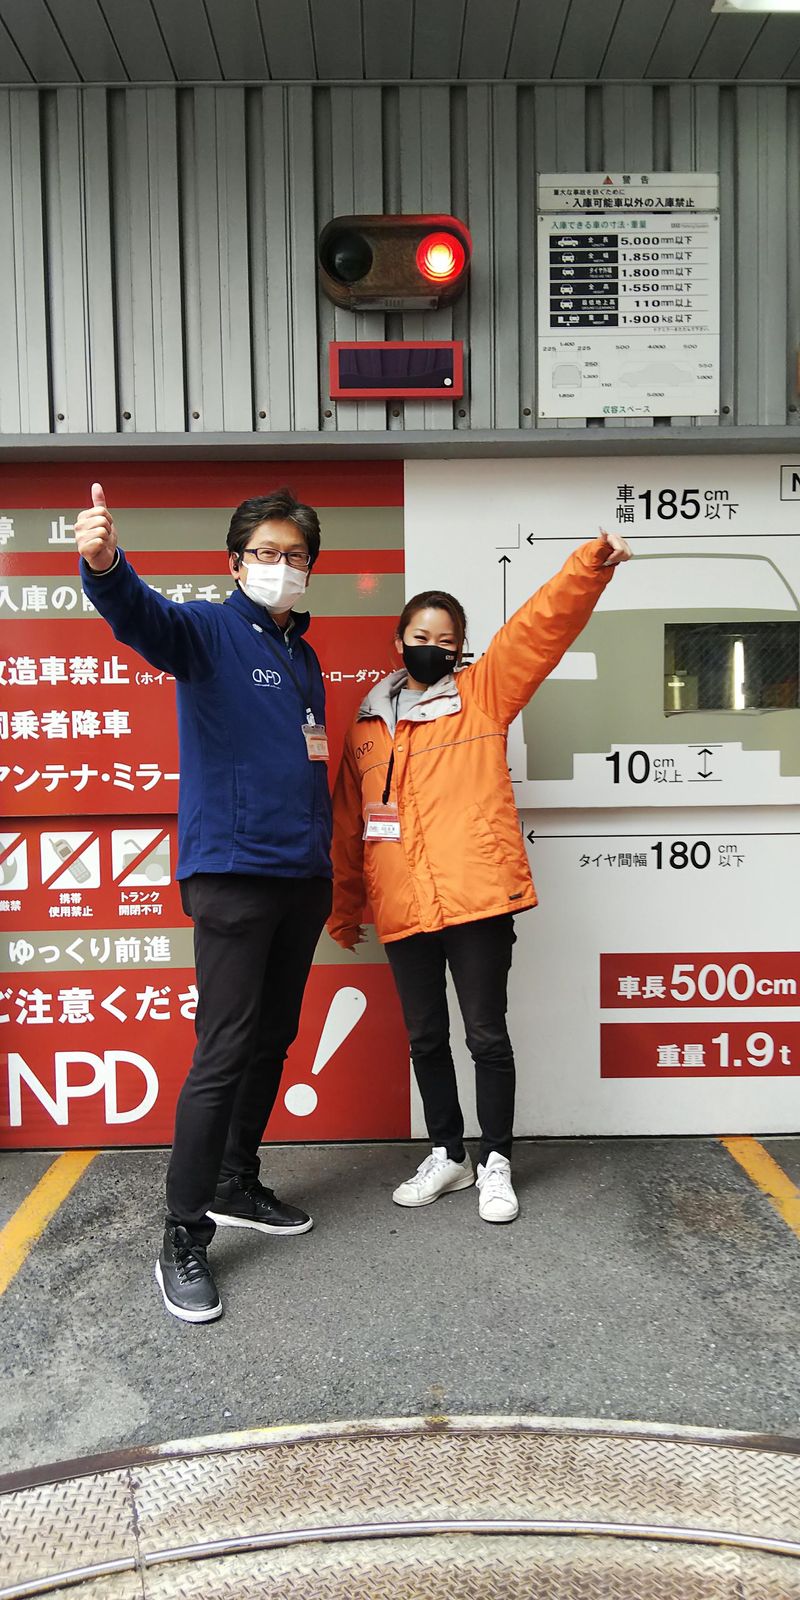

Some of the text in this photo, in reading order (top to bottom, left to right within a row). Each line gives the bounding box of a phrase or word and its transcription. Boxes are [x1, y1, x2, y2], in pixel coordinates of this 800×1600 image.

[638, 489, 700, 520] 185
[704, 490, 729, 501] cm
[704, 503, 739, 520] 以下
[605, 750, 675, 784] 10 cm
[653, 769, 684, 784] 以上
[651, 841, 711, 870] 180
[59, 891, 160, 904] 携帯 トランク
[48, 904, 163, 918] 使用禁止 開閉不可
[8, 935, 172, 966] ゆっくり前進
